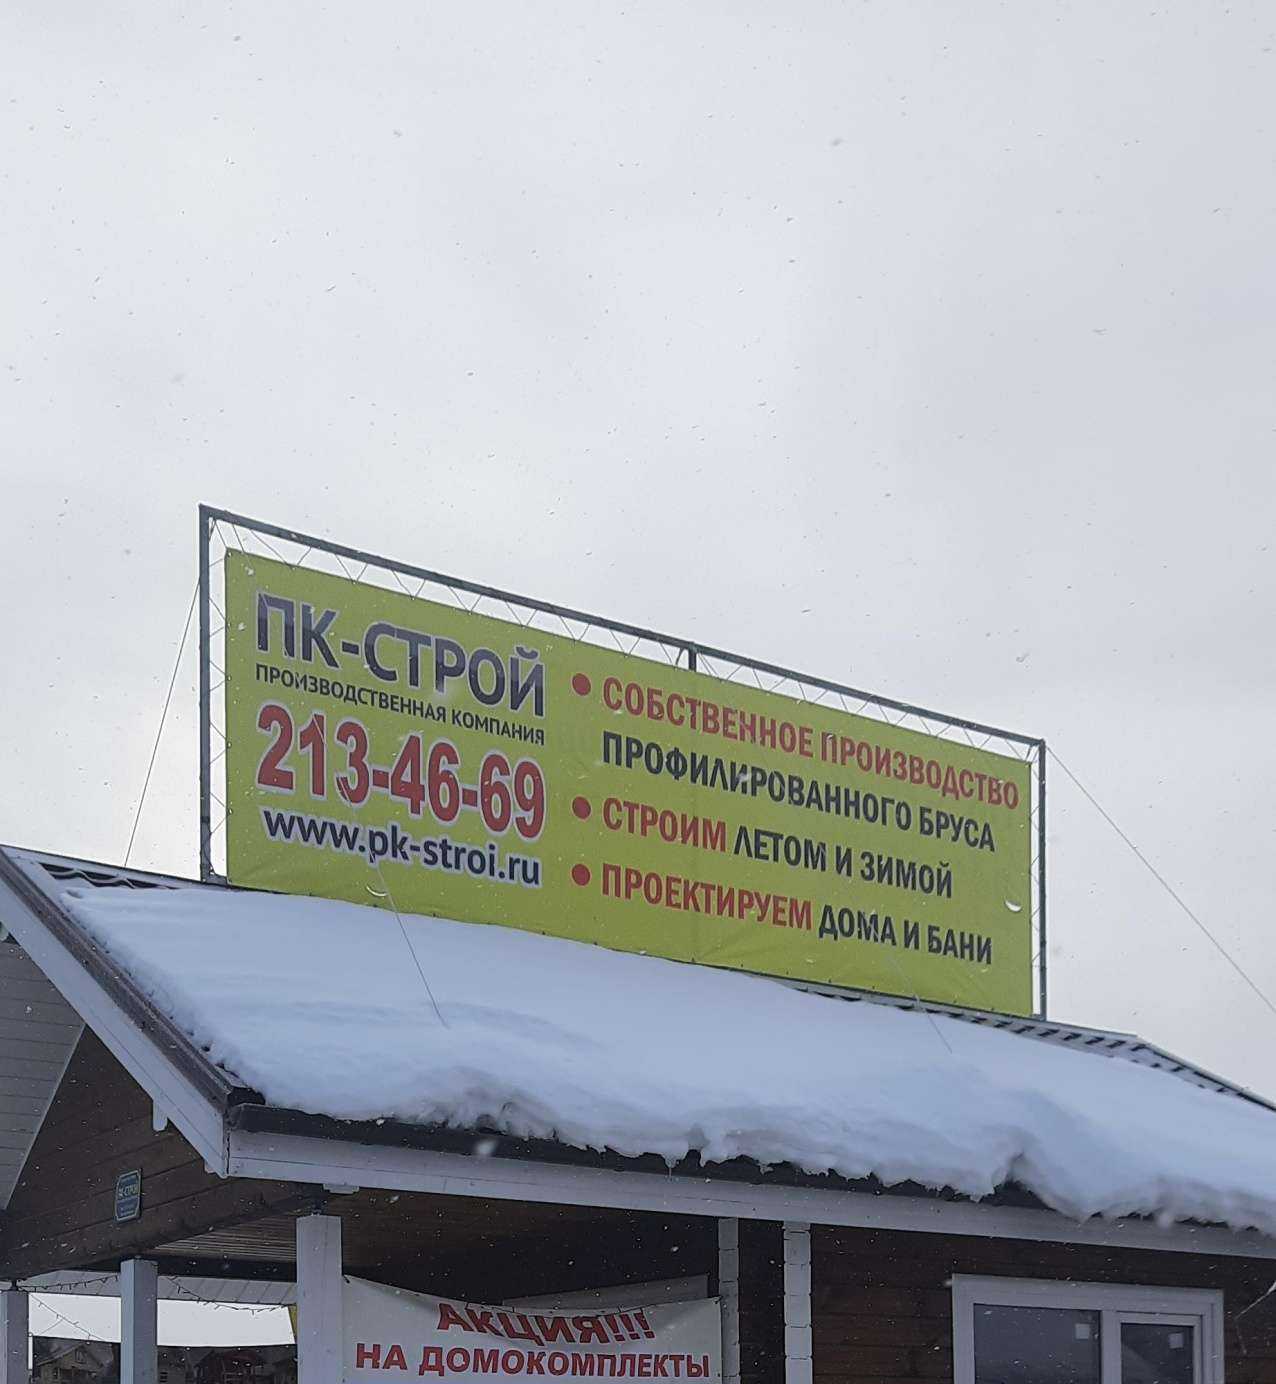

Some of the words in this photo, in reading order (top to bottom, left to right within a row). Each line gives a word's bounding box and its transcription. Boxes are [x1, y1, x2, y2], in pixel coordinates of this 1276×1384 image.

[256, 662, 447, 723] ПРОИЗВОДСТВЕННАЯ
[452, 711, 545, 746] КОМПАНИЯ
[257, 593, 545, 717] ПК-СТРОЙ
[257, 704, 545, 839] 213-46-69
[603, 676, 813, 758] СОБСТВЕННОЕ
[821, 734, 1019, 810] ПРОИЗВОДСТВО
[603, 731, 912, 831] ПРОФИЛИРОВАННОГО
[919, 807, 995, 853] БРУСА
[263, 810, 540, 885] www.pk-stroi.ru
[603, 797, 727, 853] СТРОИМ
[734, 825, 827, 871] ЛЕТОМ
[835, 848, 852, 877] И
[860, 851, 953, 899] ЗИМОЙ
[602, 863, 812, 931] ПРОЕКТИРУЕМ
[819, 904, 897, 947] ДОМА
[904, 922, 920, 950] И
[927, 925, 992, 965] БАНИ
[355, 1343, 408, 1370] НА
[419, 1345, 710, 1378] ДОМОКОМПЛЕКТЫ
[437, 1302, 656, 1346] АКЦИЯ!!!
